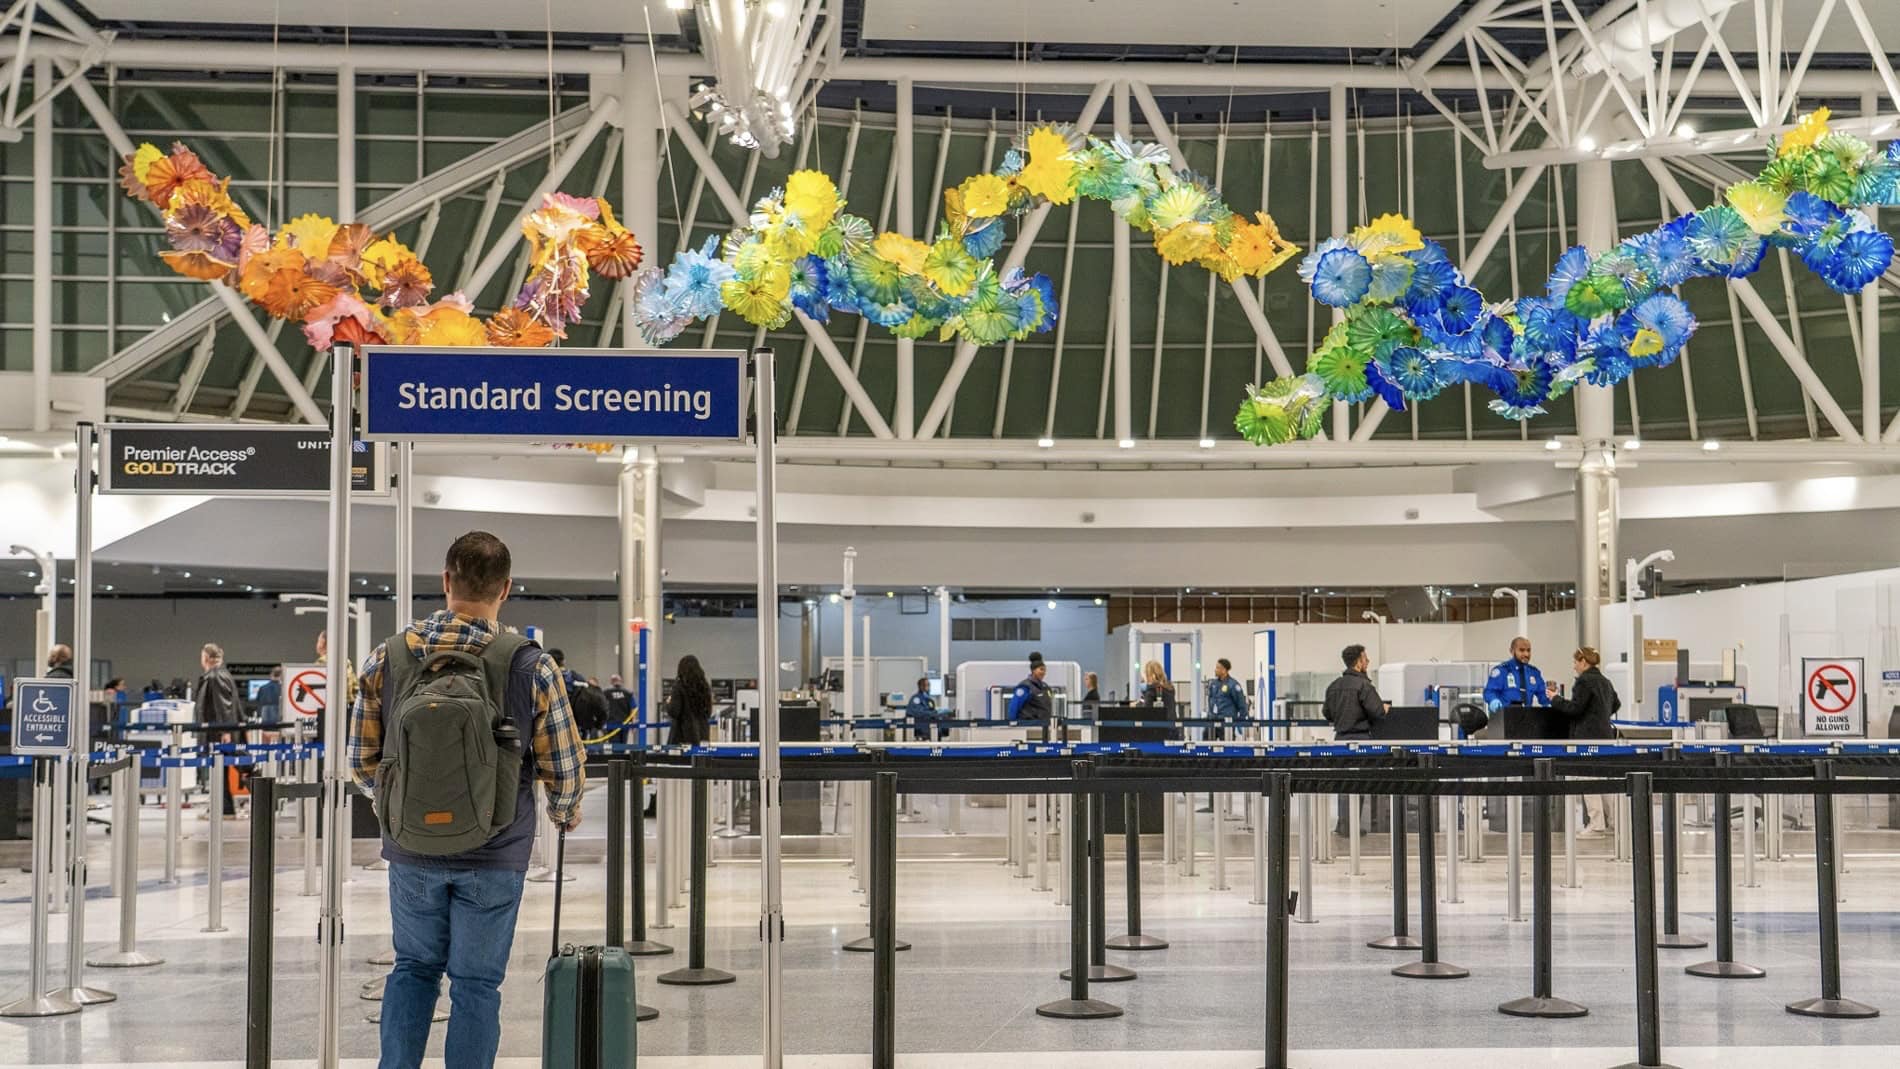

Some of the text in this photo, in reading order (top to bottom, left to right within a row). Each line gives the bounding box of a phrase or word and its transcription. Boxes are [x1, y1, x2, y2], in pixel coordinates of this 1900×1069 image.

[398, 381, 711, 420] Standard Screening
[297, 440, 331, 450] UNIT
[124, 445, 187, 461] Premier
[124, 462, 237, 475] GOLDTRACK
[23, 714, 66, 723] ACCESSIBLE
[1816, 715, 1849, 723] NO GUNS
[25, 723, 62, 732] ENTRANCE
[1815, 723, 1850, 731] ALLOWED
